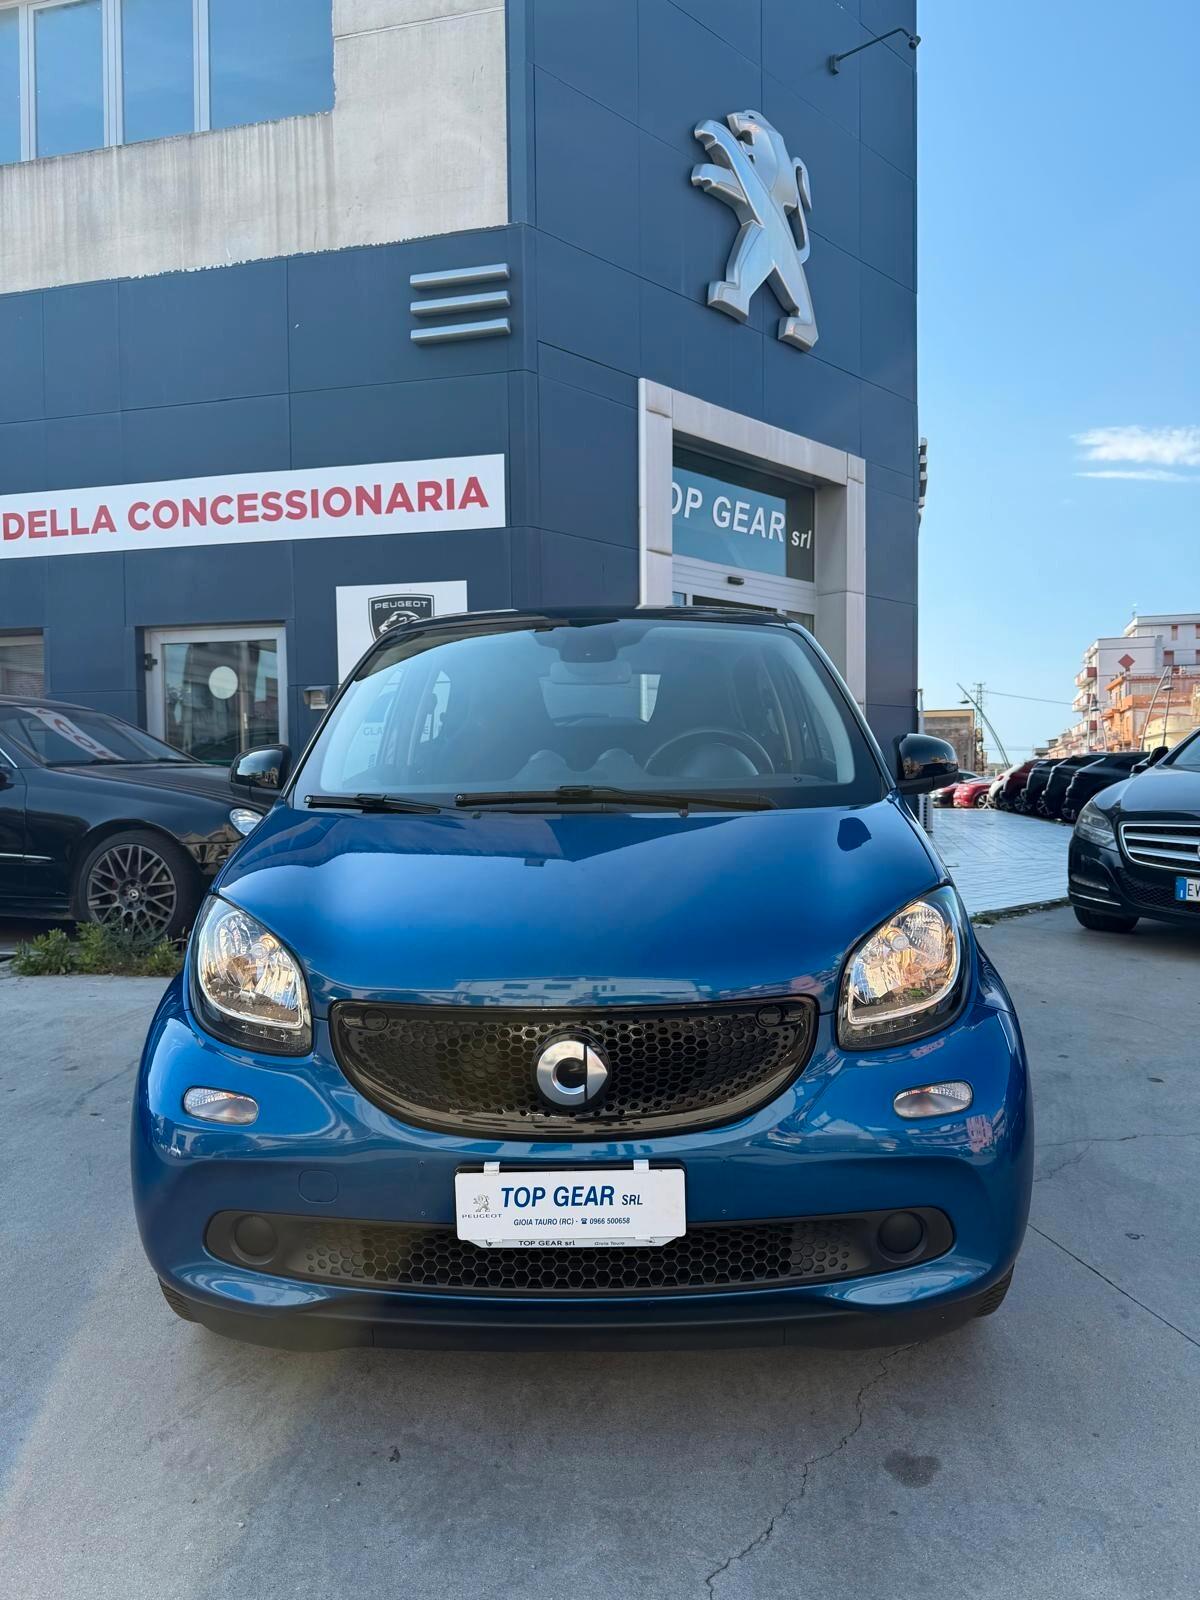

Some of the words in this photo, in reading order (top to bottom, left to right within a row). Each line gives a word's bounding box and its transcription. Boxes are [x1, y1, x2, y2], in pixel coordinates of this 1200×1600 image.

[2, 504, 117, 540] DELLA
[128, 476, 489, 531] CONCESSIONARIA
[672, 482, 703, 519] OP
[712, 496, 786, 542] GEAR
[791, 530, 812, 549] srl
[374, 600, 428, 610] PEUGEOT
[501, 1186, 546, 1208] TOP
[553, 1185, 615, 1207] GEAR
[621, 1194, 643, 1206] SRL
[513, 1218, 533, 1226] GIOIA
[535, 1218, 558, 1226] TAURO
[559, 1217, 574, 1226] (RC)
[589, 1217, 606, 1225] 0966
[606, 1217, 631, 1225] 500658
